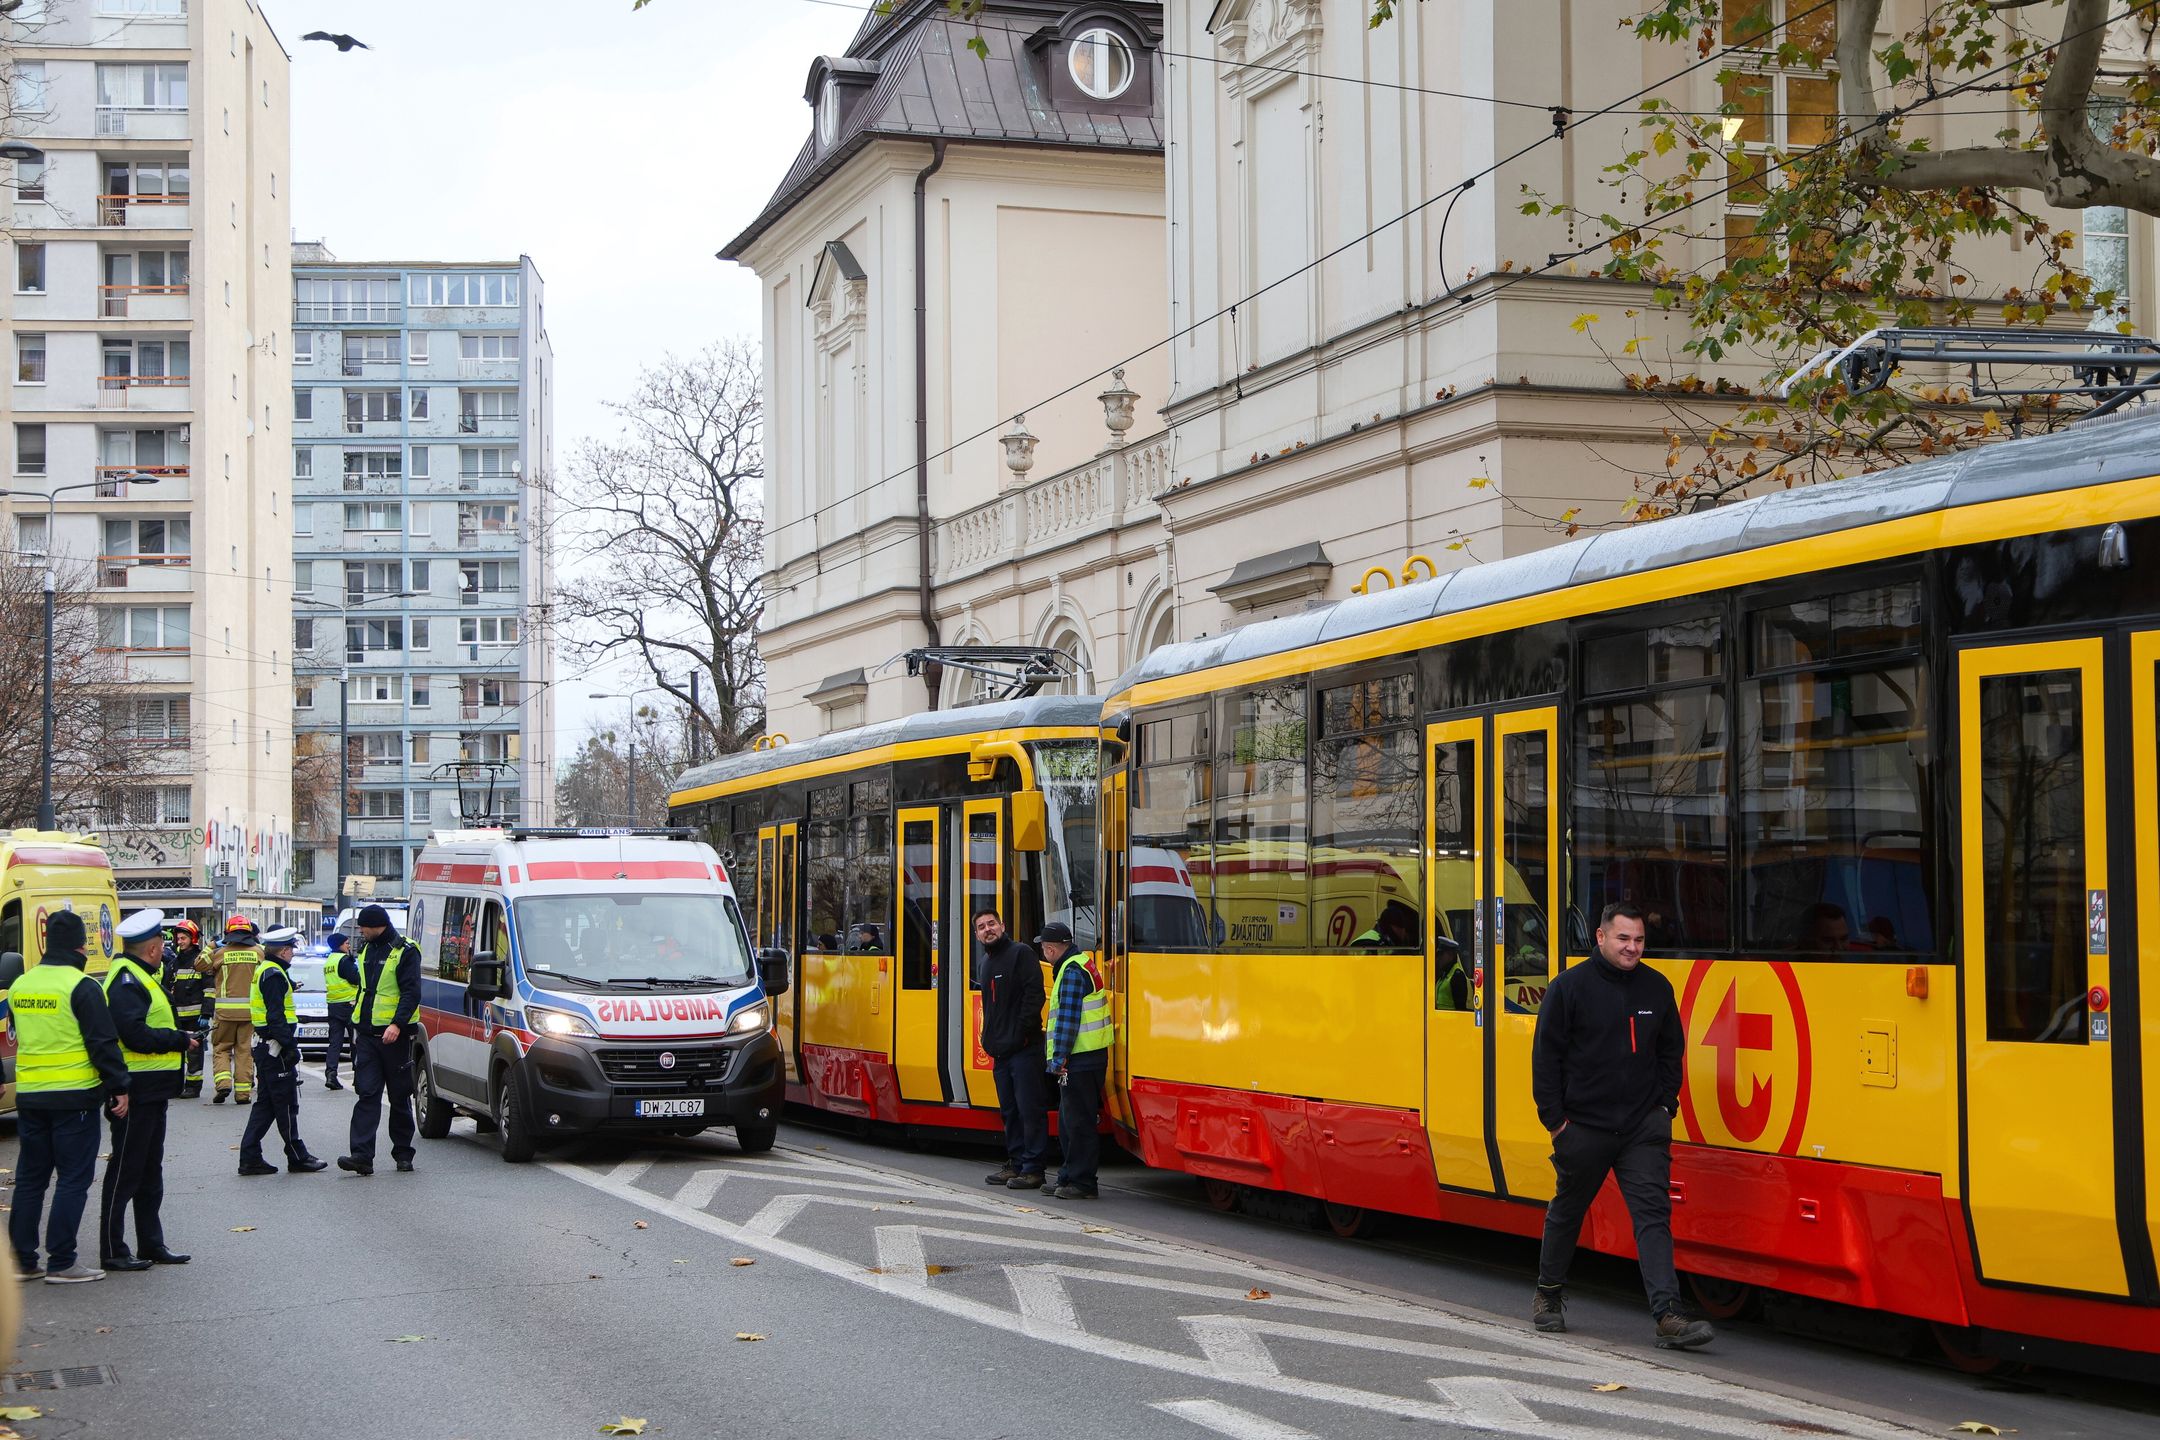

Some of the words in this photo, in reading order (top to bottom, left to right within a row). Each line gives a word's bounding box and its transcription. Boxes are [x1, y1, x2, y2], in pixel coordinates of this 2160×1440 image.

[318, 1027, 329, 1036] C2
[643, 1101, 660, 1114] DW
[664, 1100, 702, 1114] 2LC87
